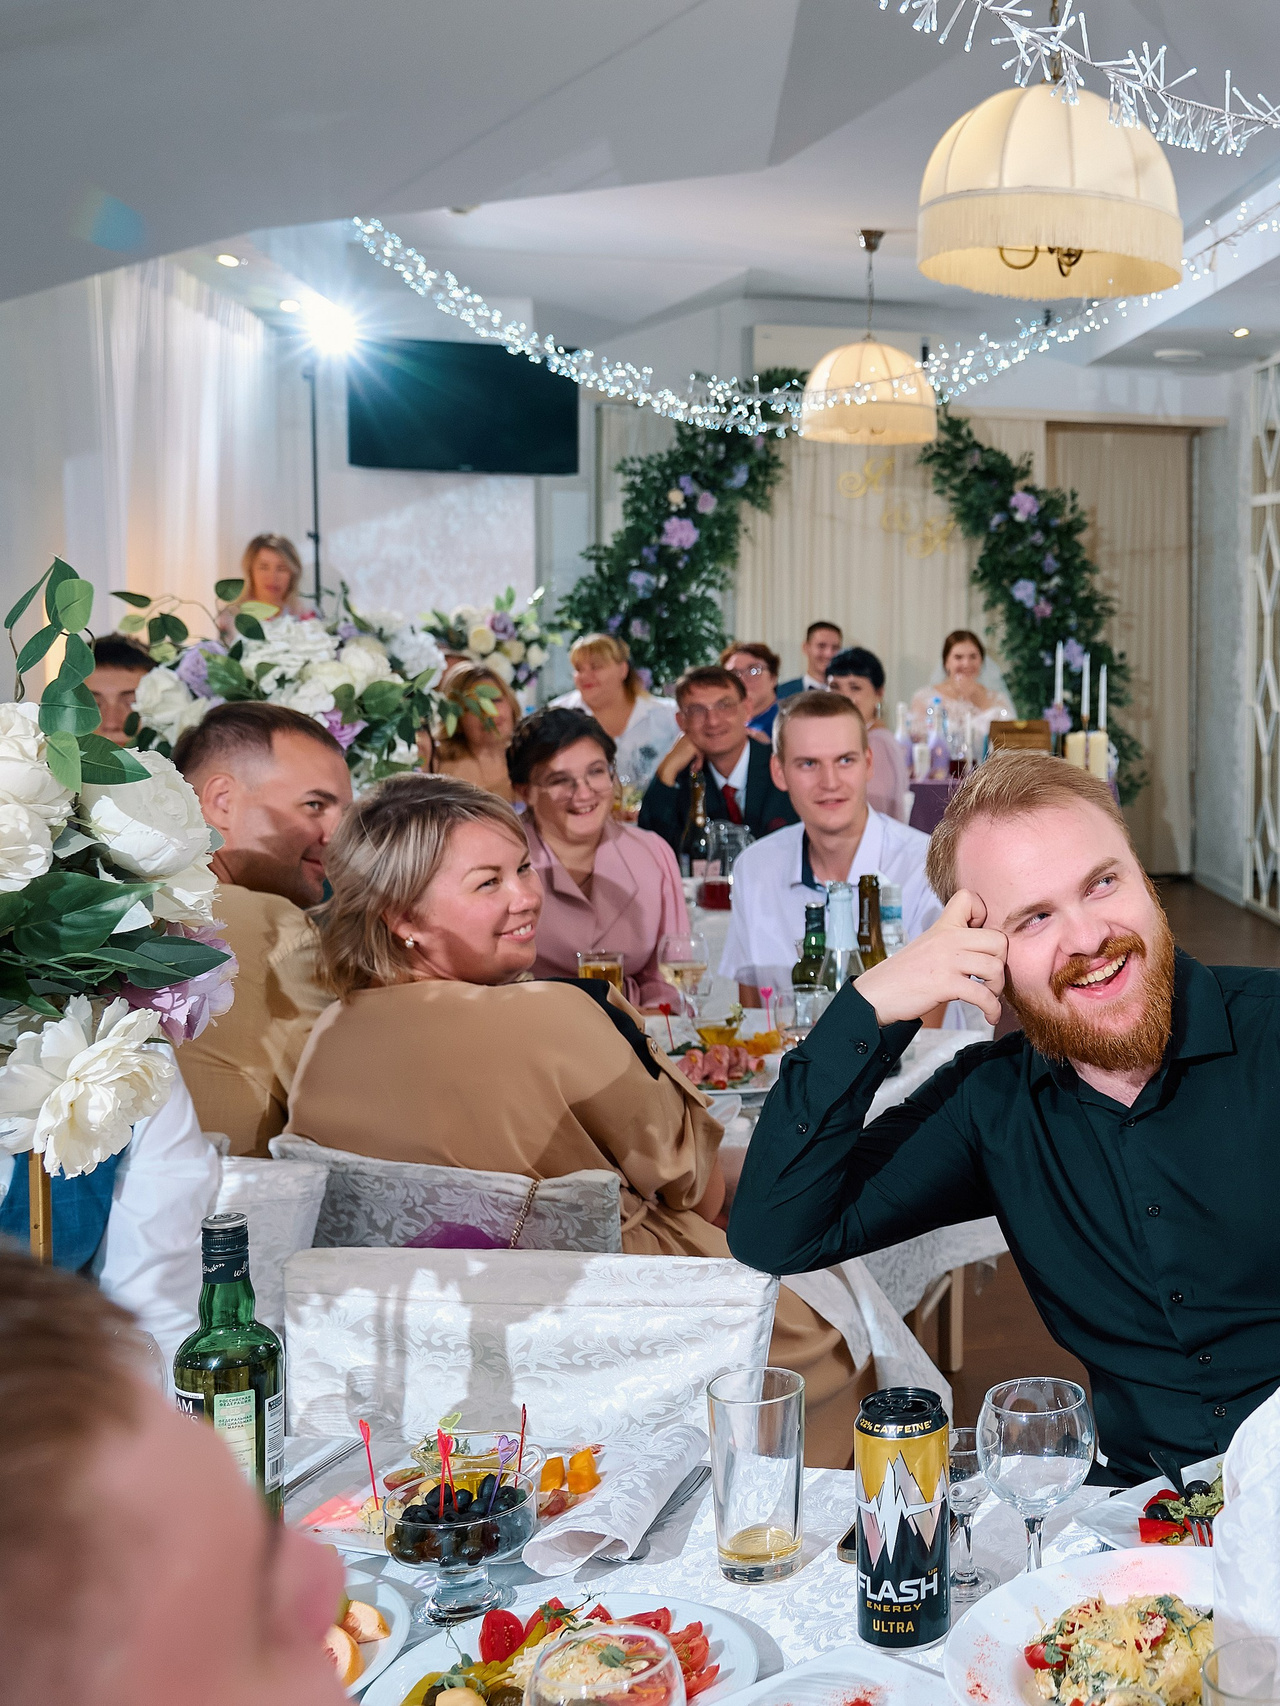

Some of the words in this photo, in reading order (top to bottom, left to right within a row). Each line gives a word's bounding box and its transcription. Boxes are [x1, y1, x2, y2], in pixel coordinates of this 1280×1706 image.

[857, 1569, 938, 1603] FLASH
[866, 1600, 922, 1613] ENERGY
[872, 1618, 915, 1633] ULTRA
